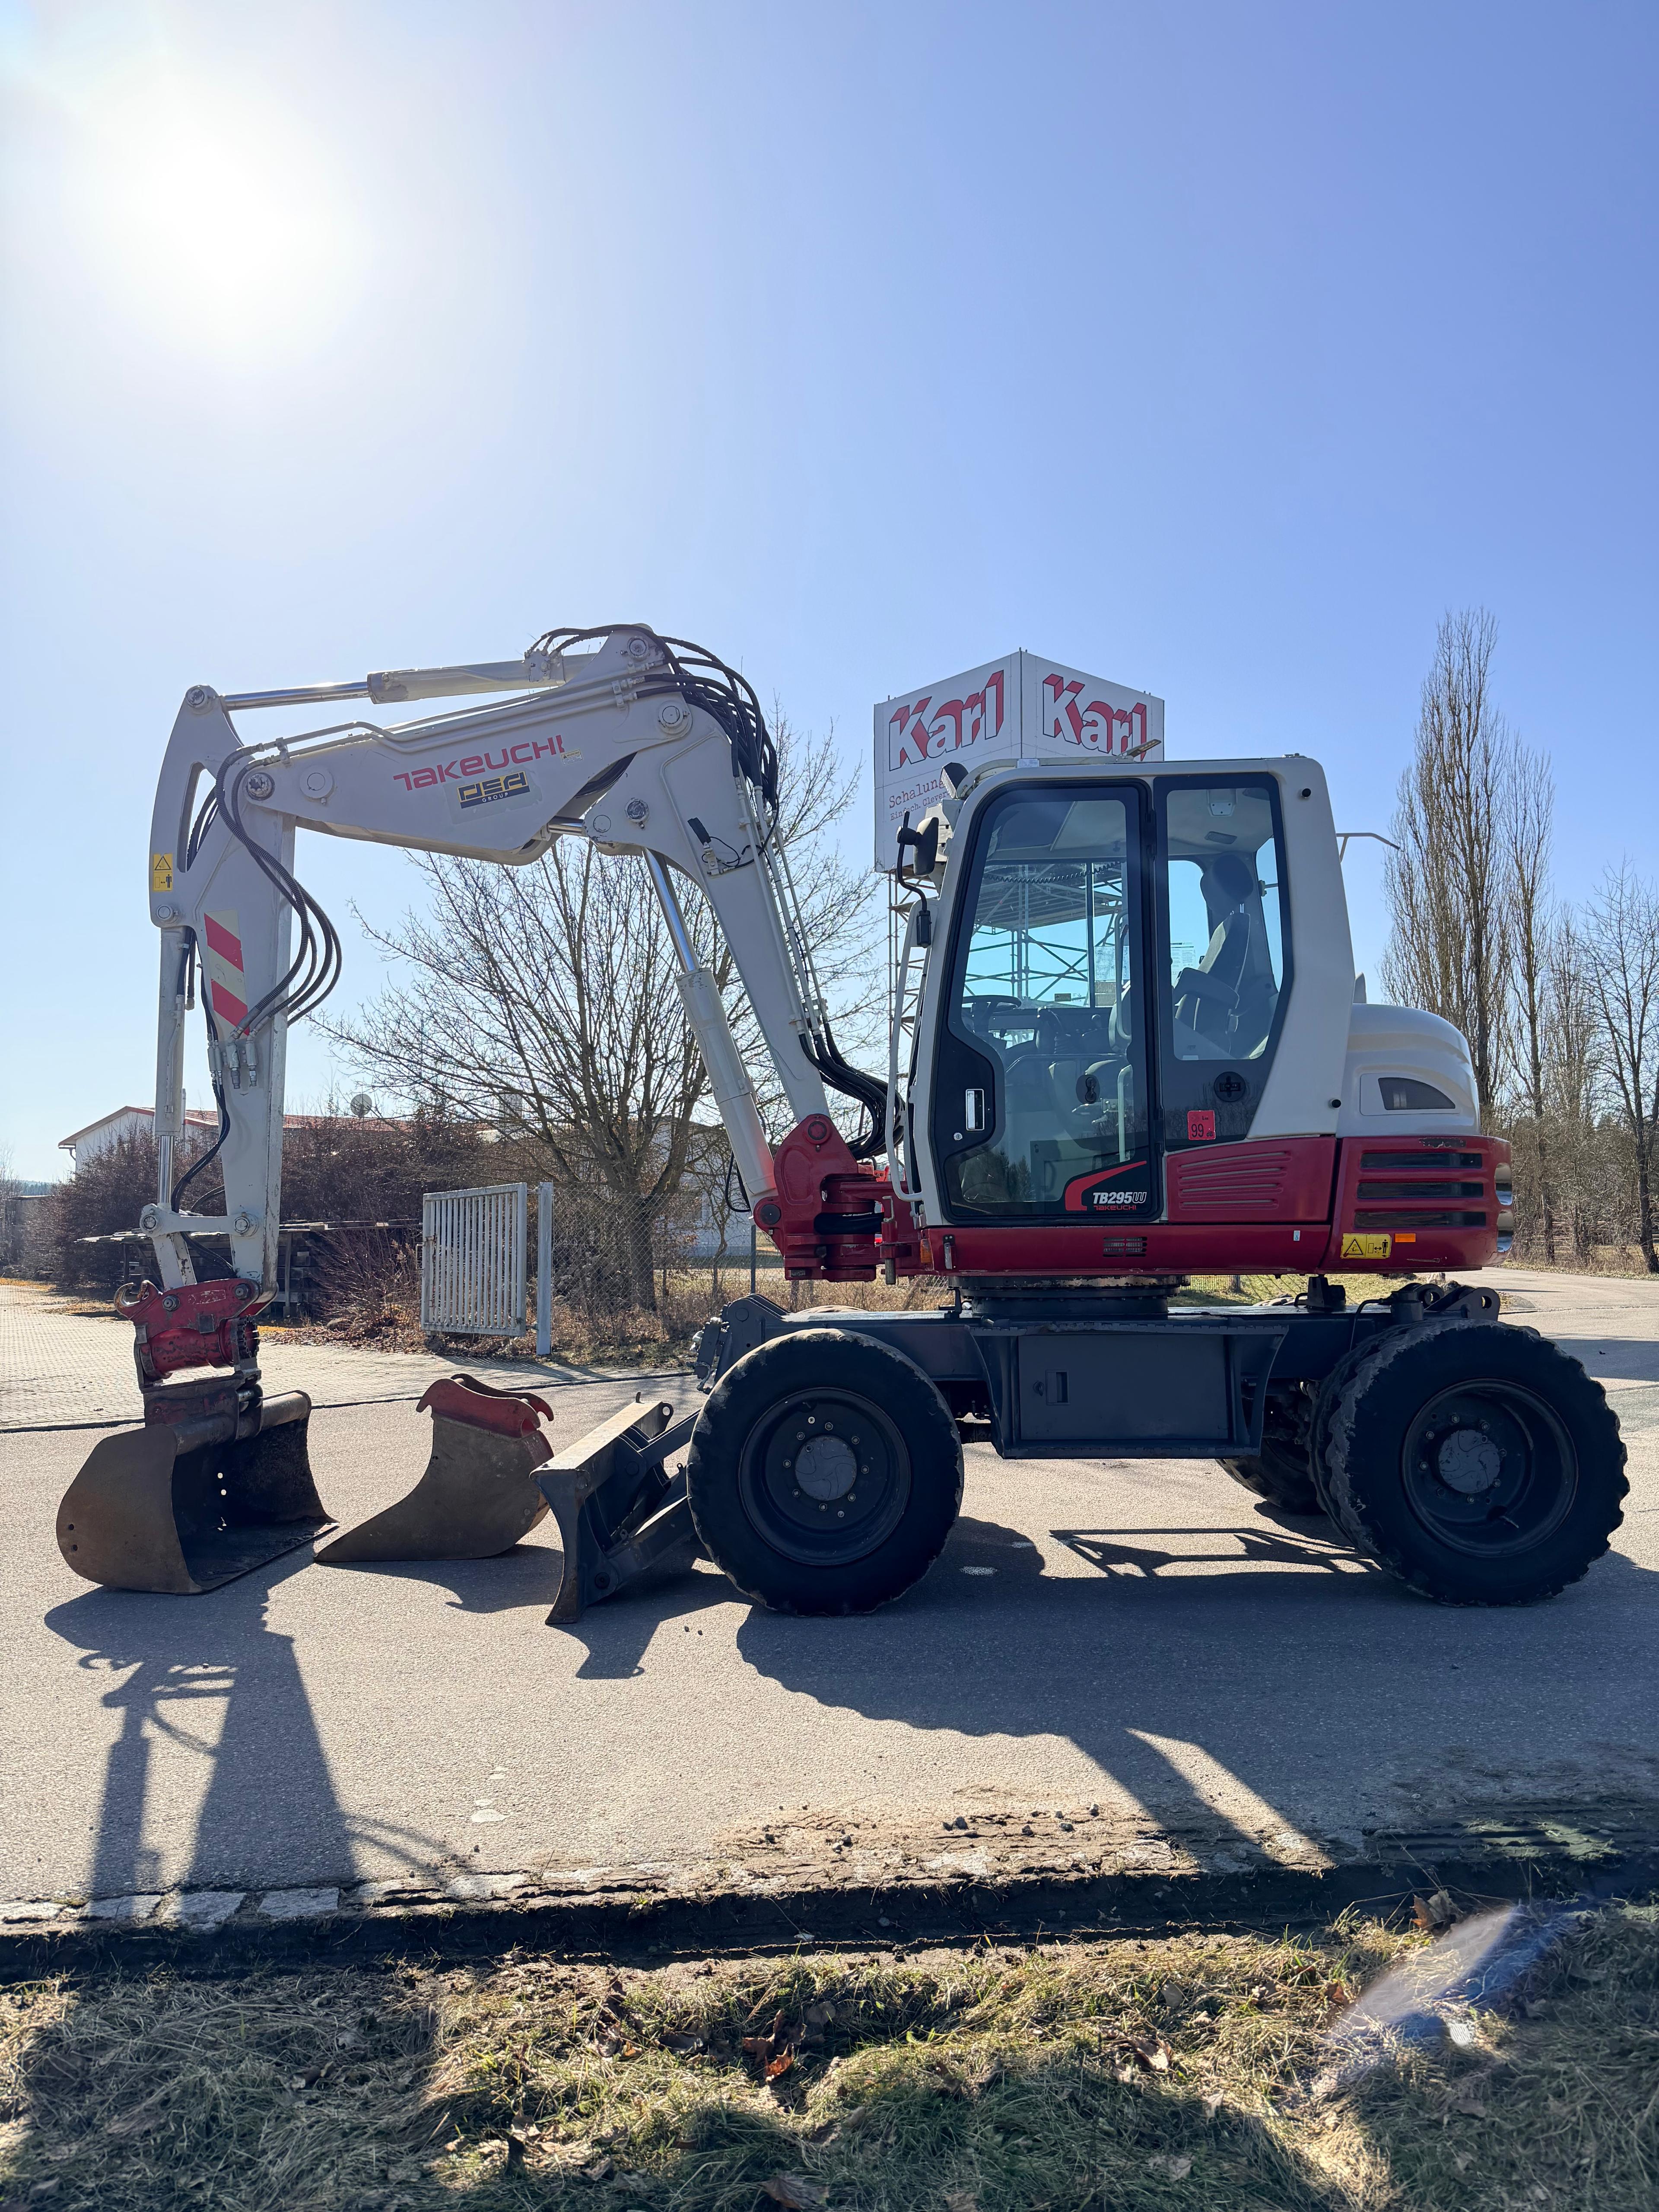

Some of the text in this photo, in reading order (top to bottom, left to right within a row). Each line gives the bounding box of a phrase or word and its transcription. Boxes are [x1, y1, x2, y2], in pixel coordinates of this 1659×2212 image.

[889, 670, 1004, 772] Karl
[1042, 673, 1147, 762] Karl
[393, 734, 565, 791] TAKEUCHI
[482, 792, 508, 802] GROUP
[1191, 1124, 1204, 1138] 99
[1093, 1192, 1147, 1204] TB295W
